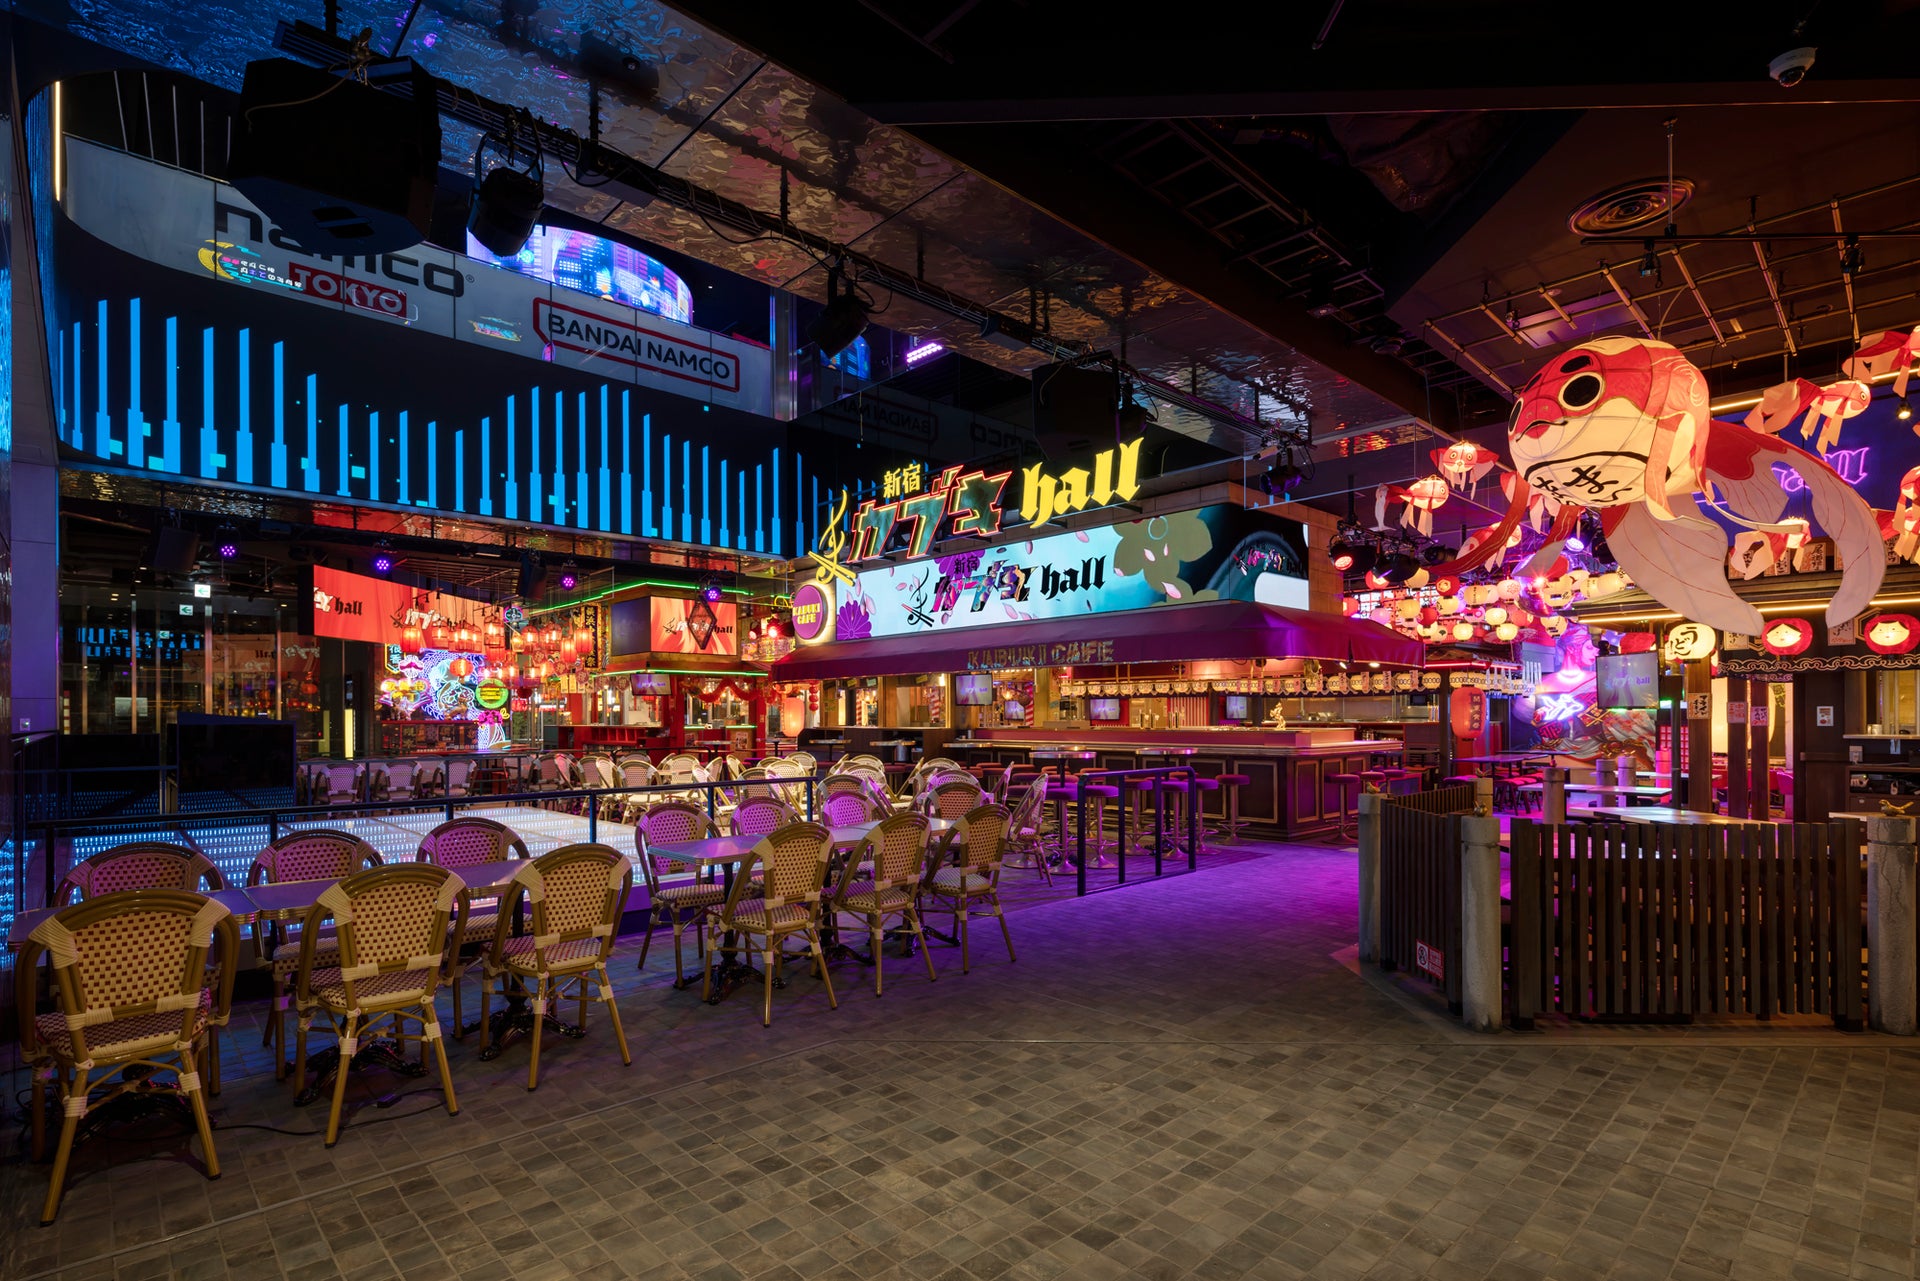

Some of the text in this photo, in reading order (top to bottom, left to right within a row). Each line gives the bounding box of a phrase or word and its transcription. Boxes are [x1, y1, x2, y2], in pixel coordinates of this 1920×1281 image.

[293, 267, 403, 314] TOKYO
[548, 313, 642, 356] BANDAI
[647, 340, 730, 380] NAMCO
[883, 463, 921, 498] 新宿
[846, 437, 1144, 563] カブキ hall
[954, 556, 979, 574] 新宿
[1040, 555, 1107, 600] hall
[334, 597, 363, 616] hall
[793, 602, 820, 616] KABUKI
[797, 613, 816, 625] CAFE
[967, 640, 1114, 669] KABUKI CAFE
